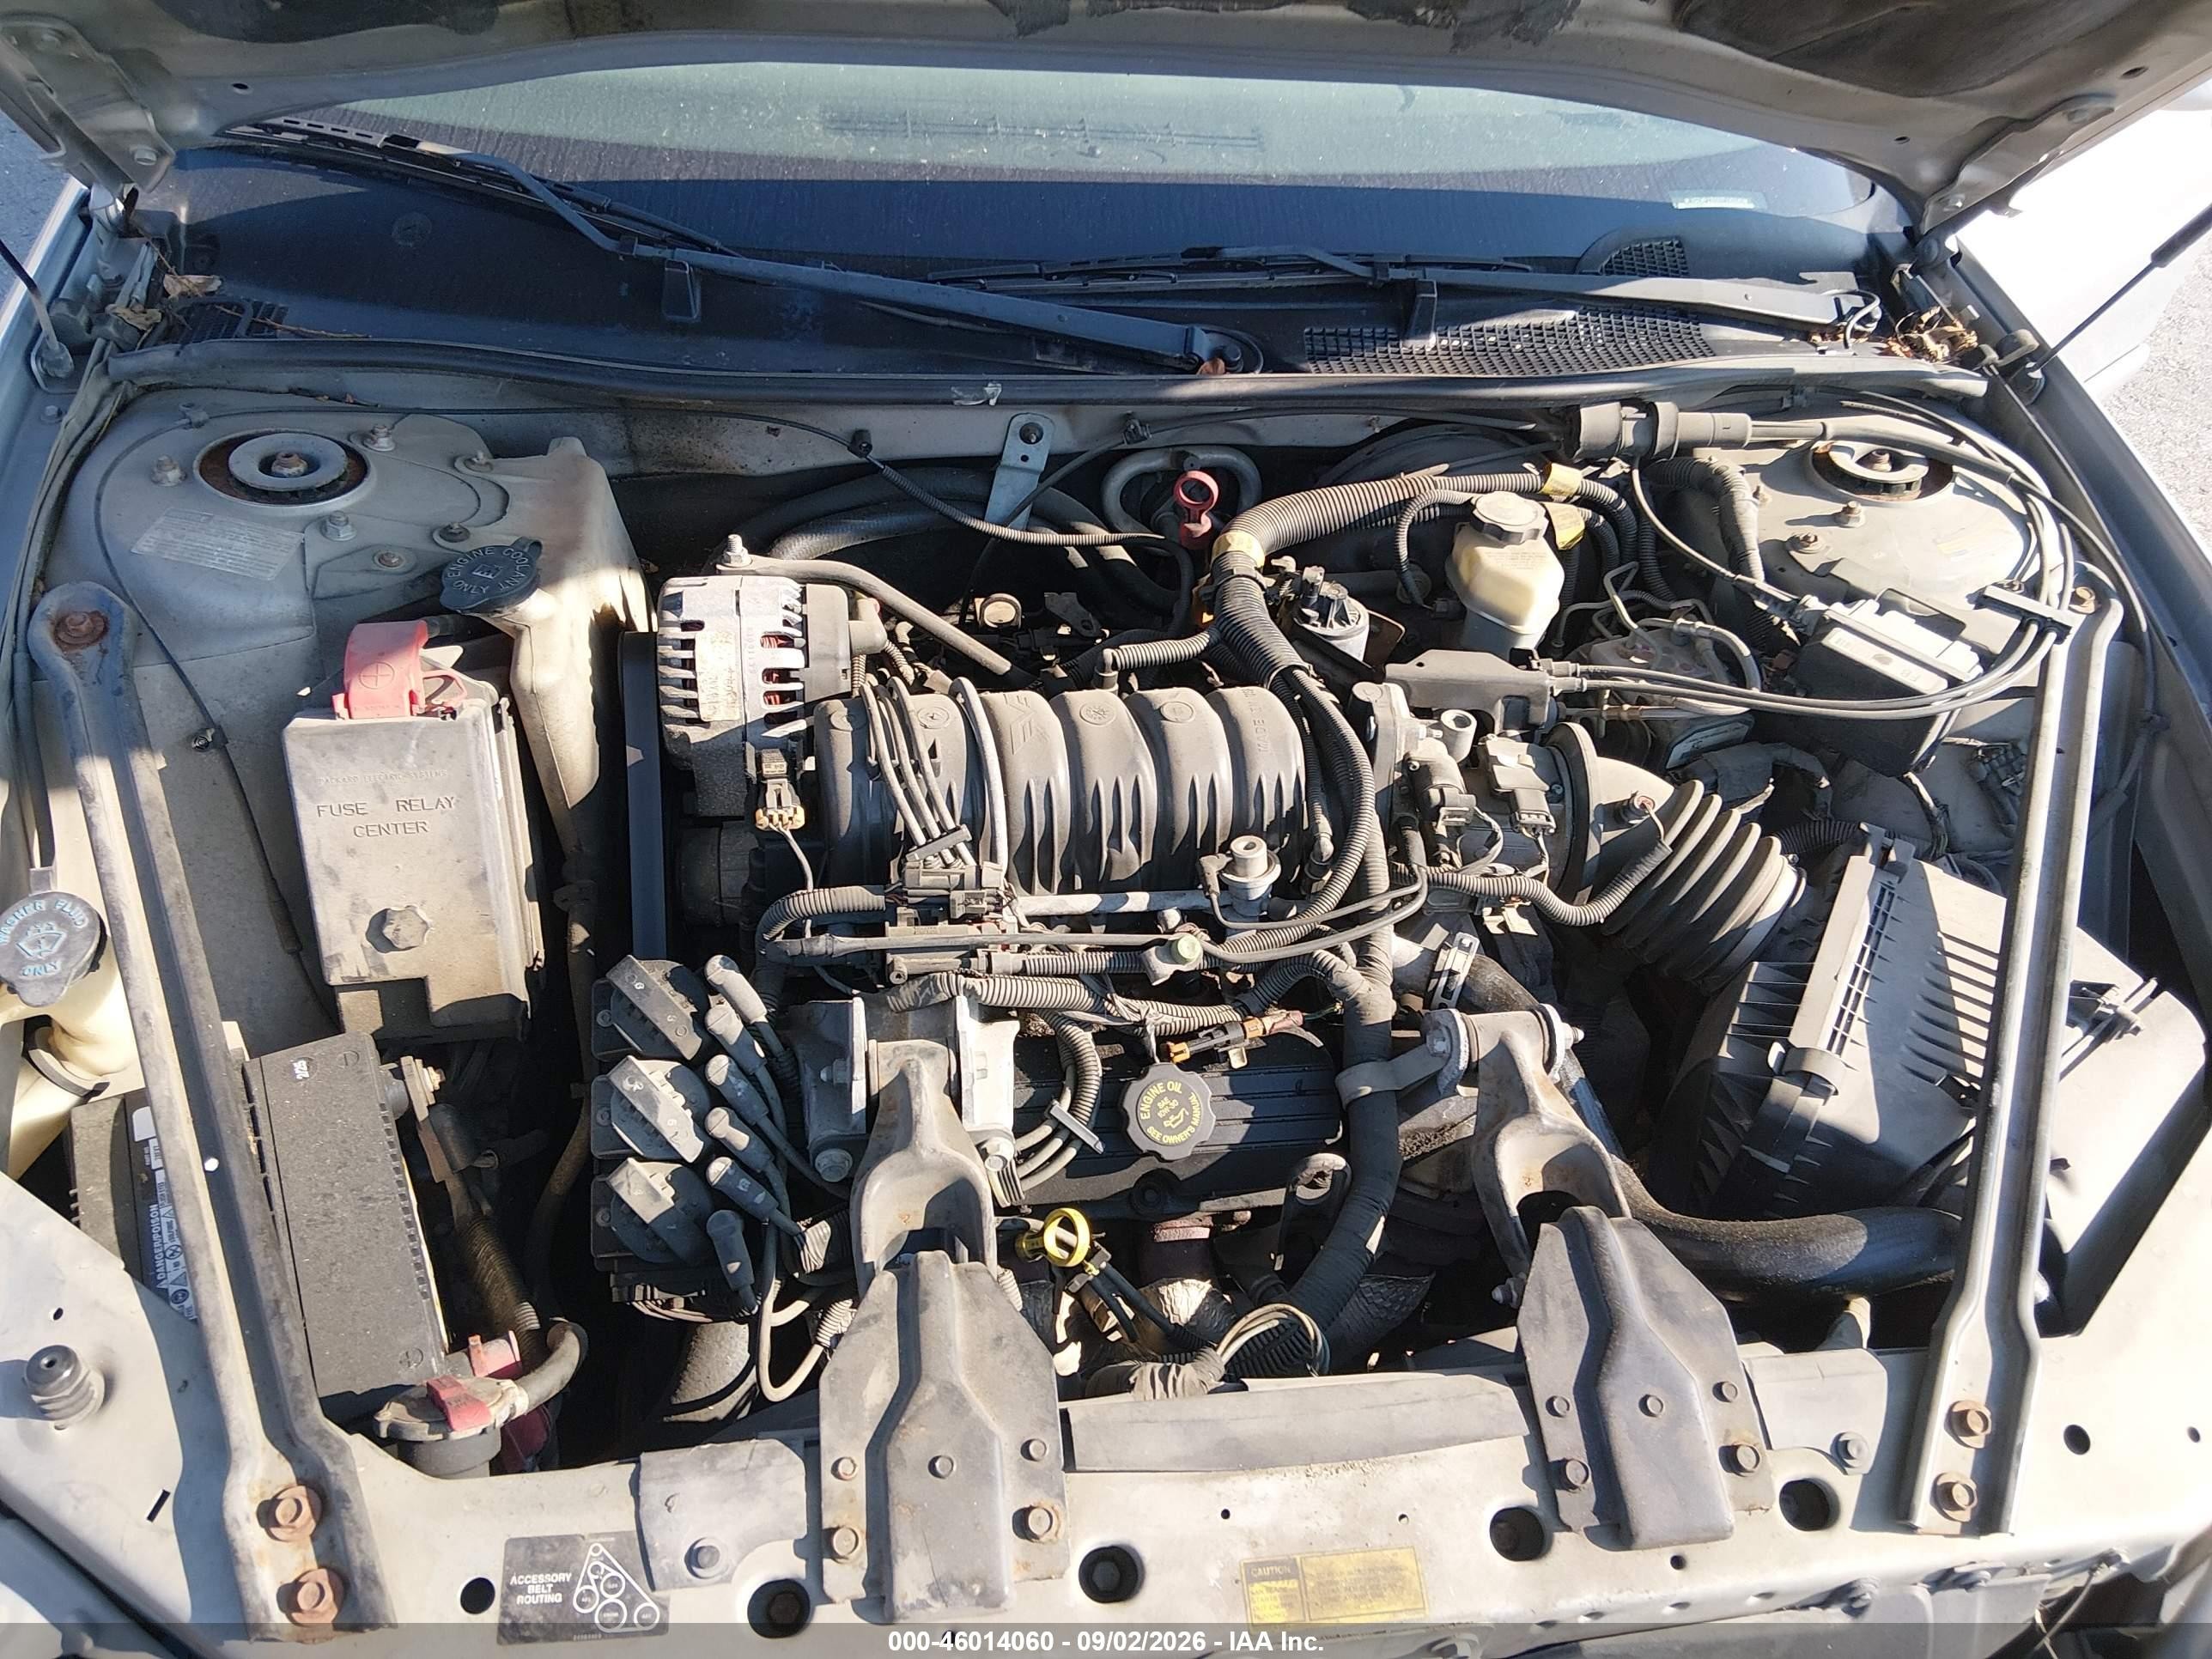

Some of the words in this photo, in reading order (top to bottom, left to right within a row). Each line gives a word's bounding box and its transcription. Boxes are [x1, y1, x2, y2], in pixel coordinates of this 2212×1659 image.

[447, 547, 495, 578] ENGINE
[499, 548, 530, 591] COOLANT
[453, 580, 489, 593] ONLY
[317, 802, 369, 817] FUSE
[396, 796, 455, 812] RELAY
[353, 821, 428, 838] CENTER
[55, 900, 88, 927] FLUID
[22, 961, 58, 976] ONLY
[1140, 1083, 1166, 1120] ENGINE
[1167, 1081, 1182, 1094] OIL
[1147, 1127, 1163, 1140] SEE
[1162, 1126, 1195, 1144] OWNER'S
[1188, 1092, 1201, 1127] MANUAL
[149, 1204, 167, 1280] DANGER/POISON
[509, 1572, 572, 1585] ACCESSORY
[1251, 1565, 1291, 1577] CAUTION
[527, 1583, 554, 1595] BELT
[517, 1593, 563, 1605] ROUTING
